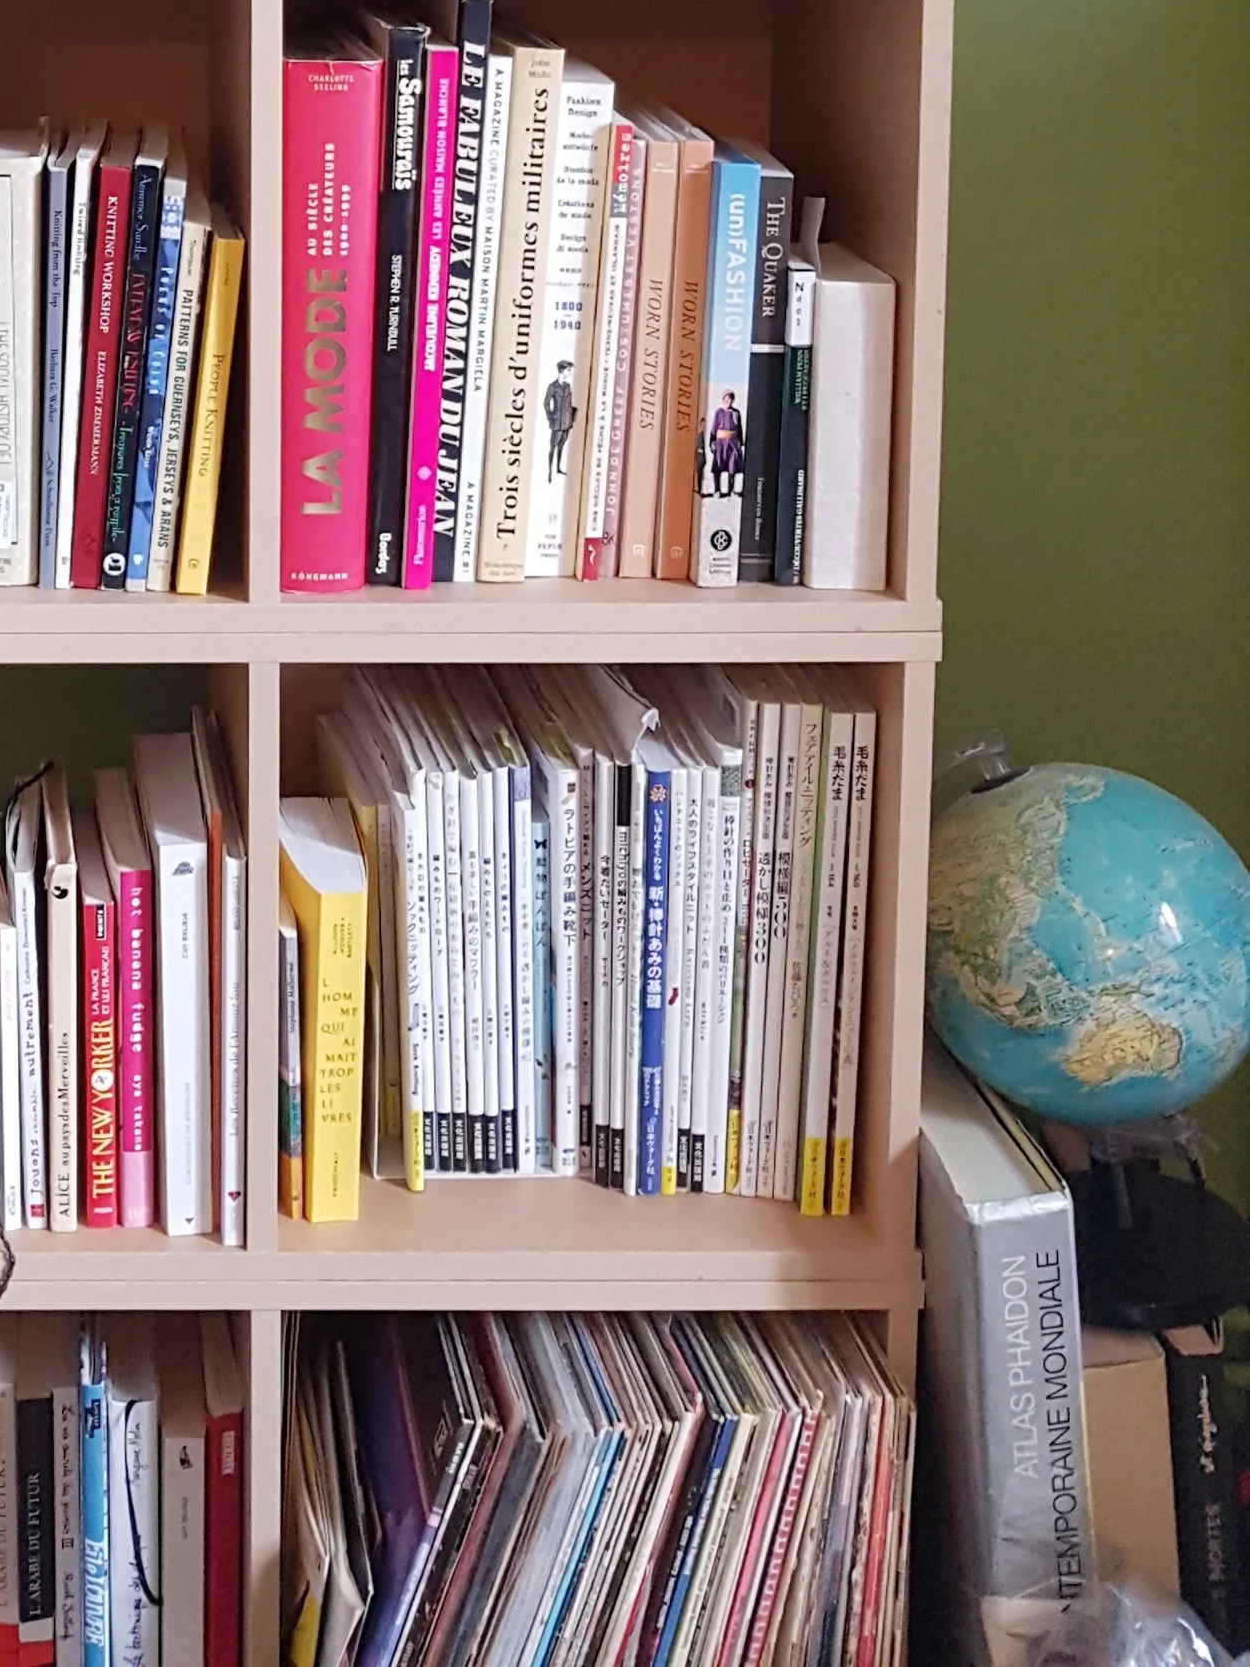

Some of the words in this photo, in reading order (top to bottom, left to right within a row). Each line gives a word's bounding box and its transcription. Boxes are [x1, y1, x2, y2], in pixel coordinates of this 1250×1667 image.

[398, 59, 412, 75] les
[462, 40, 485, 87] LE
[393, 77, 422, 191] Samouraïs
[520, 87, 549, 214] militaires
[449, 96, 481, 267] FABULEUX
[508, 221, 540, 380] d'uniformes
[722, 193, 748, 351] (un)FASHION
[175, 289, 195, 347] PATTERNS
[440, 284, 471, 392] ROMAN
[645, 278, 663, 341] WORN
[174, 350, 190, 372] FOR
[301, 268, 347, 433] MODE
[166, 375, 189, 445] GUERNSEYS,
[437, 399, 462, 443] DU
[640, 347, 661, 431] STORIES
[500, 386, 526, 467] siècles
[161, 498, 175, 506] &
[162, 448, 182, 495] JERSEYS
[300, 448, 343, 515] LA
[433, 449, 459, 537] JEAN
[157, 509, 174, 548] ARANS
[495, 475, 519, 541] Trois
[130, 887, 146, 916] hot
[130, 928, 145, 990] banana
[130, 1003, 146, 1053] fudge
[91, 1107, 113, 1156] NEW
[92, 1161, 113, 1199] THE
[1002, 1255, 1035, 1386] PHAIDON
[1035, 1249, 1070, 1400] MONDIALE
[1010, 1391, 1042, 1479] ATLAS
